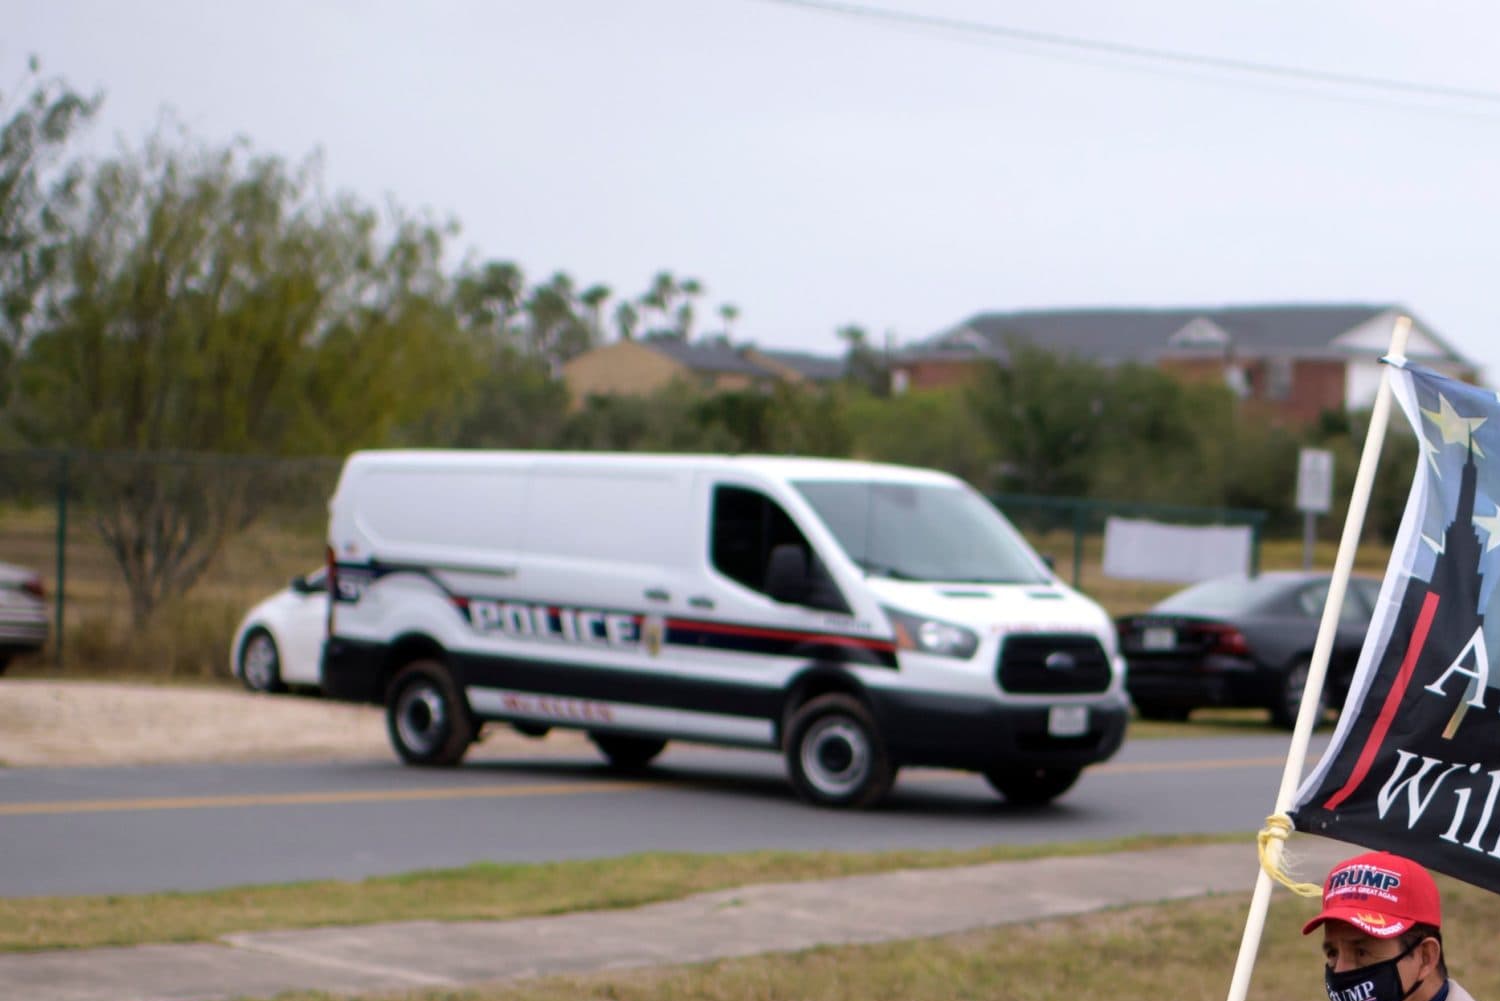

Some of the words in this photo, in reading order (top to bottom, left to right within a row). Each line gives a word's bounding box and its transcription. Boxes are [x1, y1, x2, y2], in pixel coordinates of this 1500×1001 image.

[470, 601, 641, 648] POLICE
[1424, 625, 1487, 709] A
[1328, 869, 1400, 892] TRUMP
